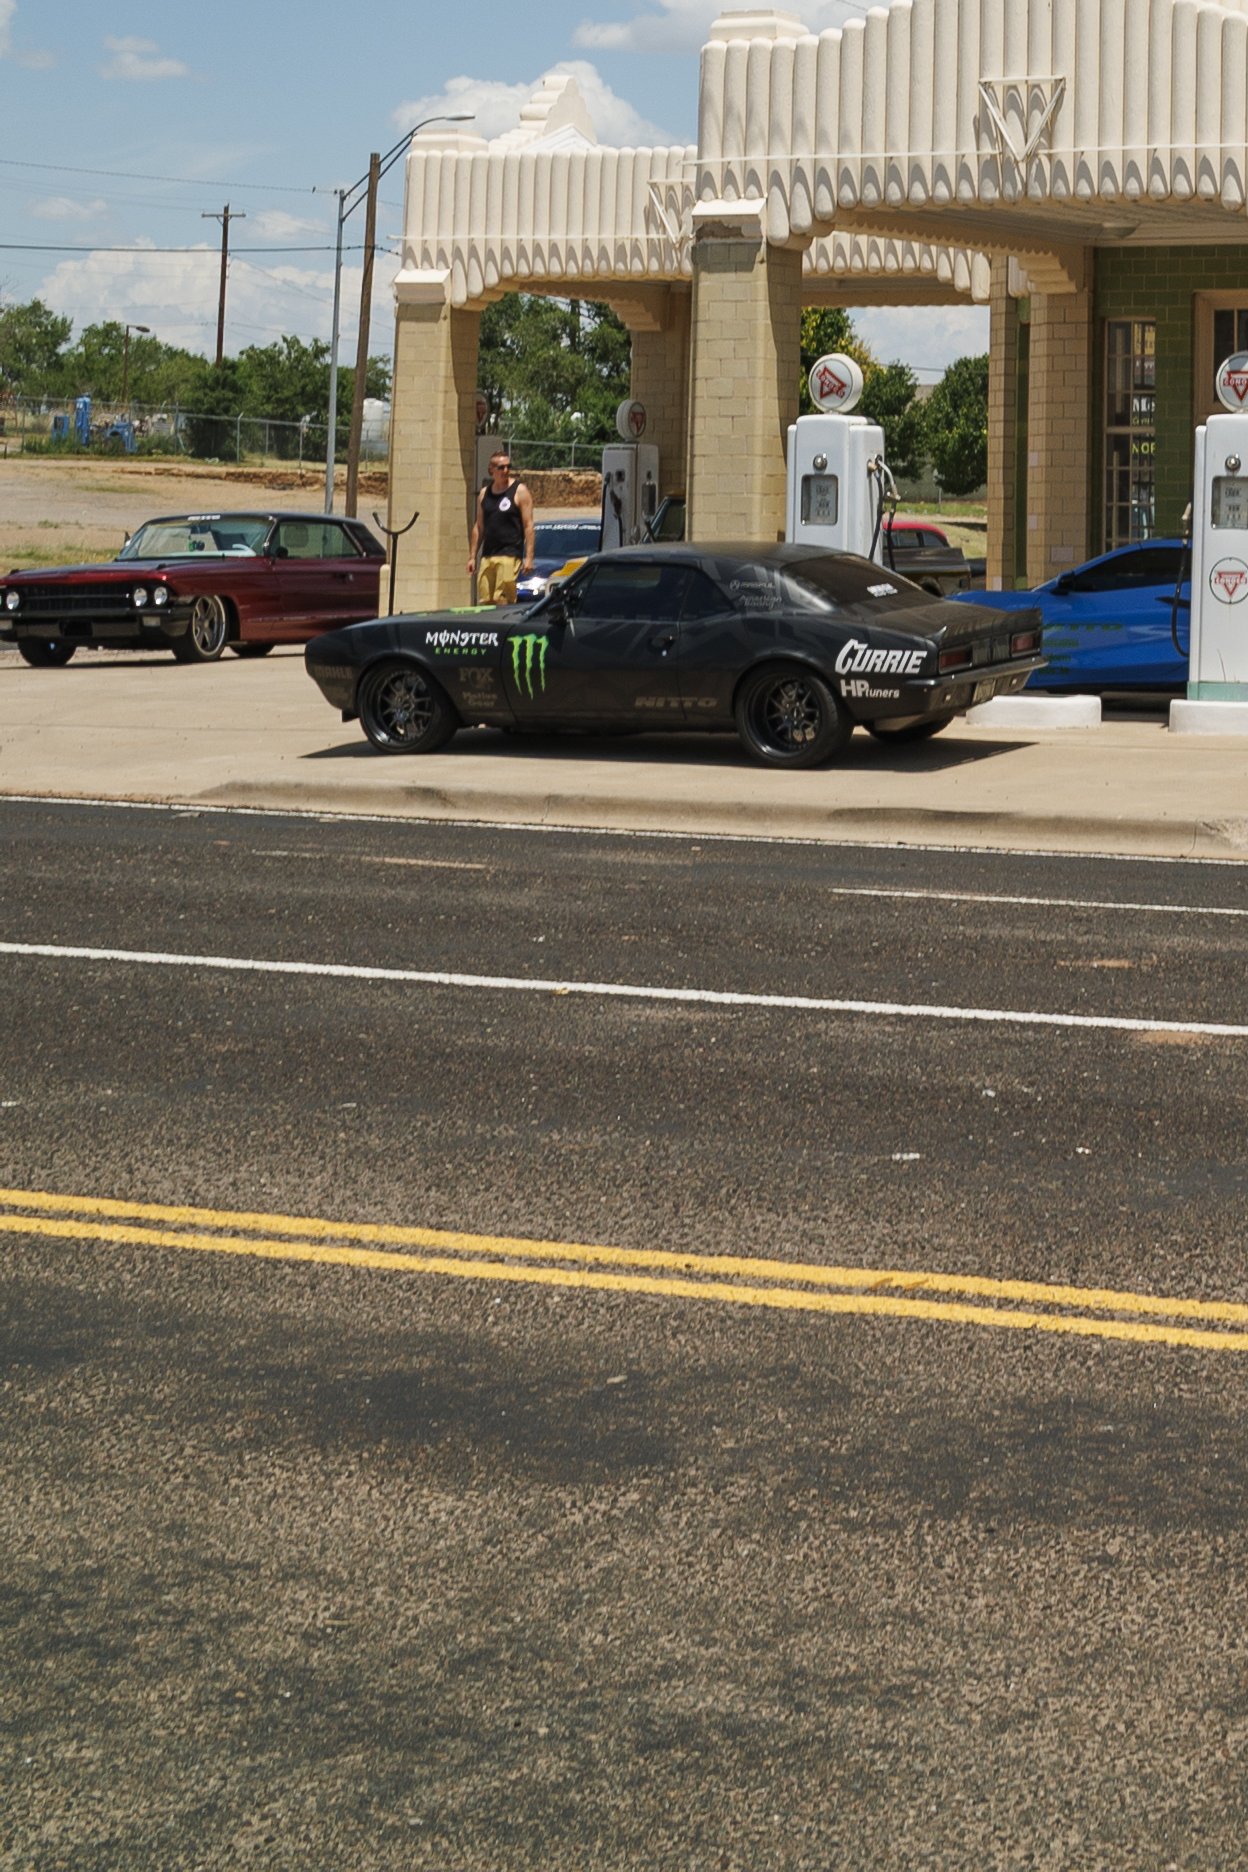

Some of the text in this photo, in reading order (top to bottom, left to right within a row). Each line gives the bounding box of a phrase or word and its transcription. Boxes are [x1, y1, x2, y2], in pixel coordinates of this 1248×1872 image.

[425, 630, 499, 647] MONSTER
[435, 647, 487, 656] ENERGY
[834, 638, 928, 675] CURRIE
[634, 696, 719, 707] NITTO
